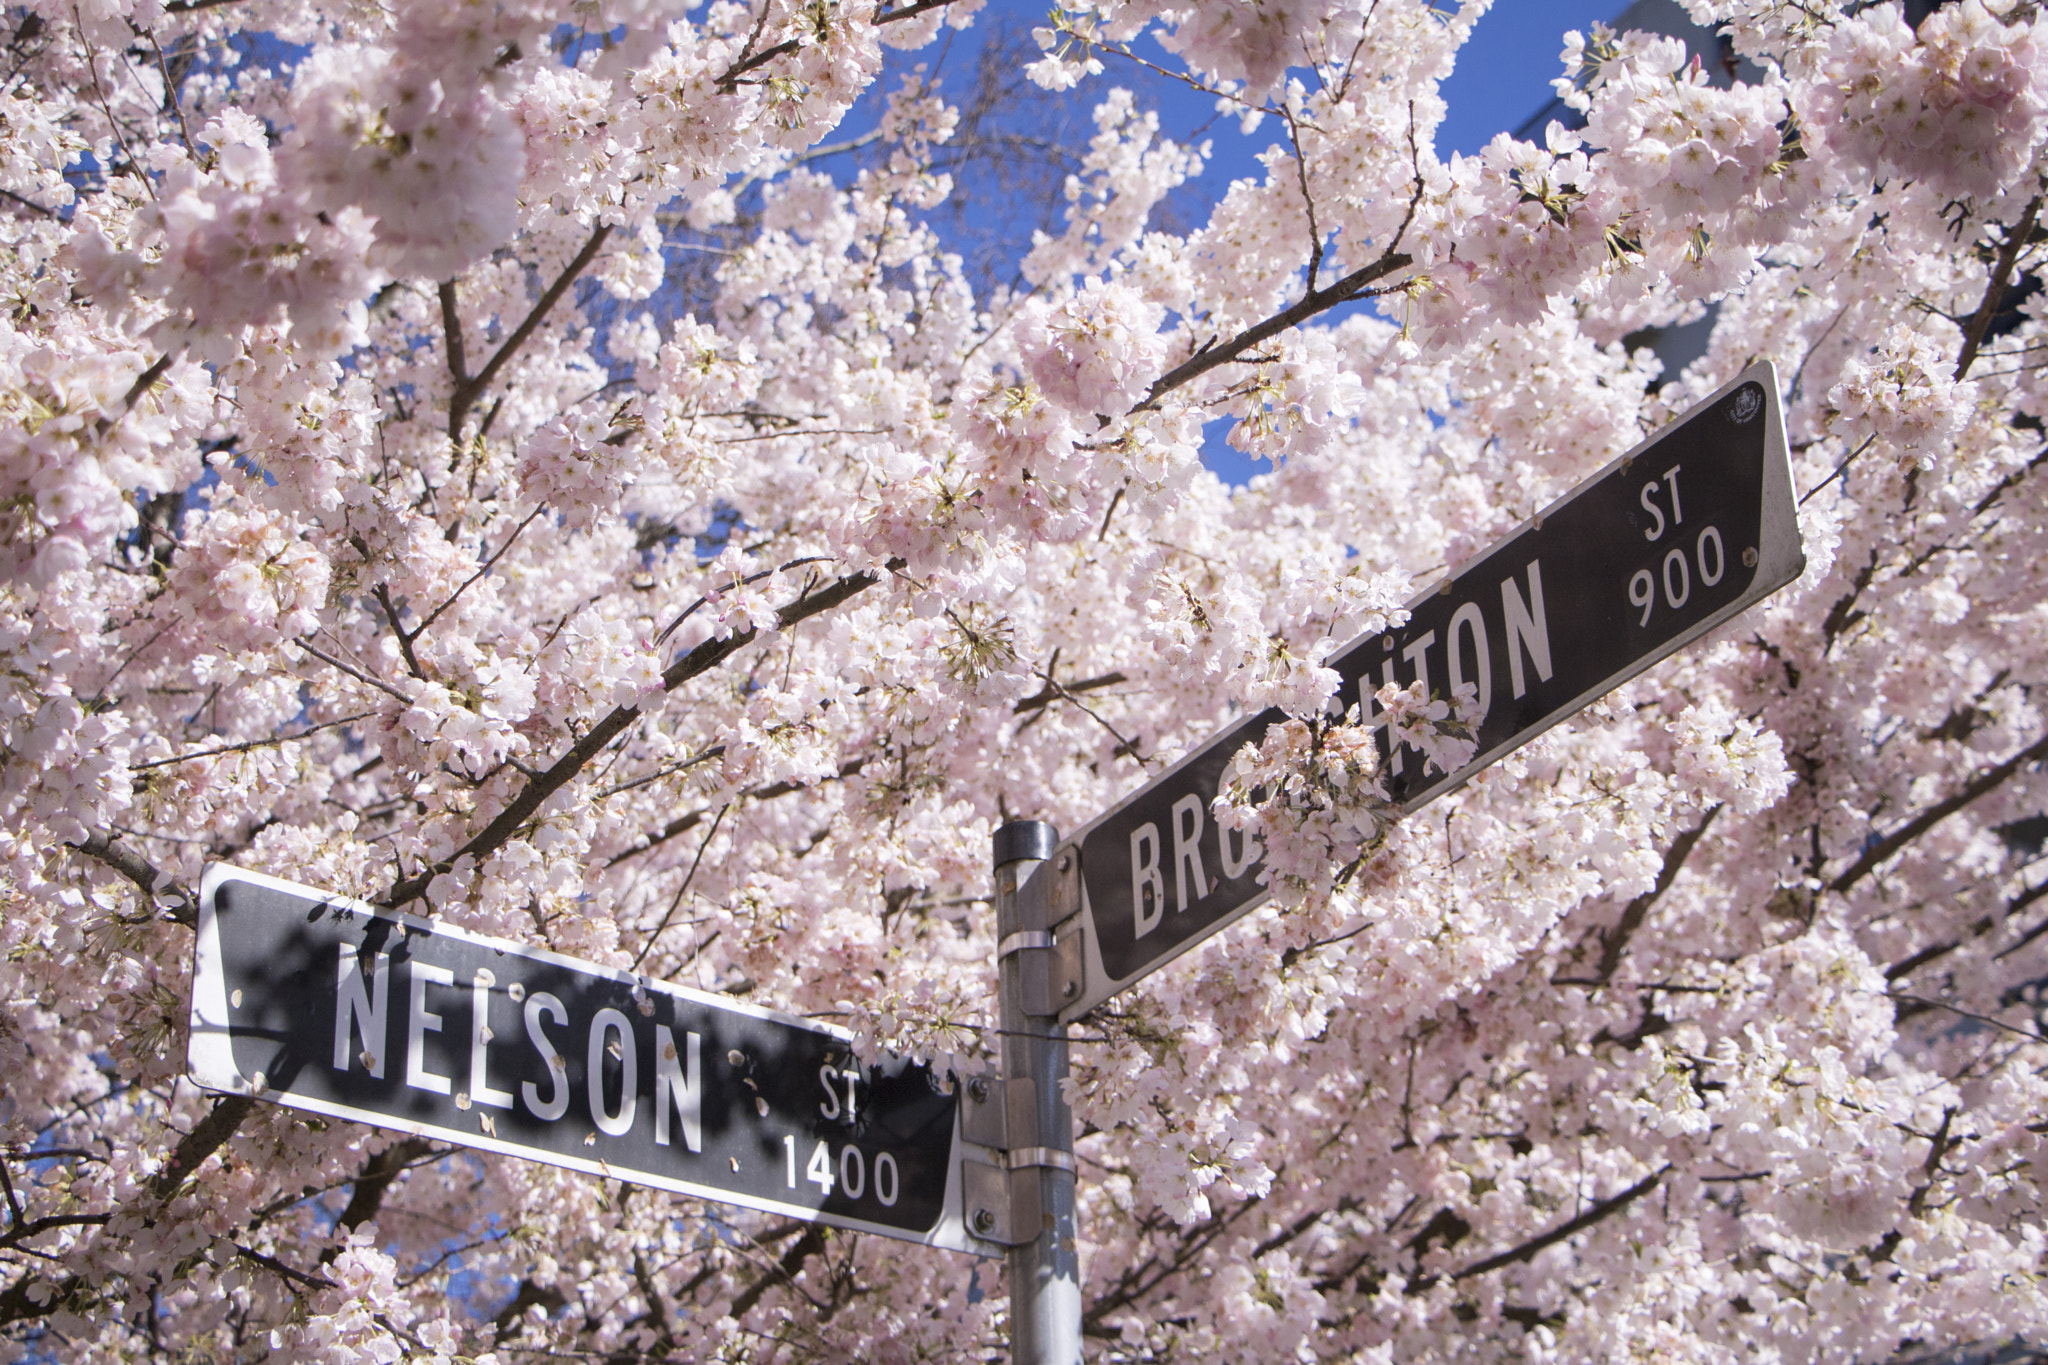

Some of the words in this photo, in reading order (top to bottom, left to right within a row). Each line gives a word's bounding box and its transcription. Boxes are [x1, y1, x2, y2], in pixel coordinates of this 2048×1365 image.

[1640, 464, 1682, 541] ST
[1628, 525, 1724, 628] 900
[1131, 559, 1553, 941] BROHTON
[333, 943, 701, 1153] NELSON
[819, 1064, 860, 1124] ST
[784, 1134, 899, 1207] 1400
